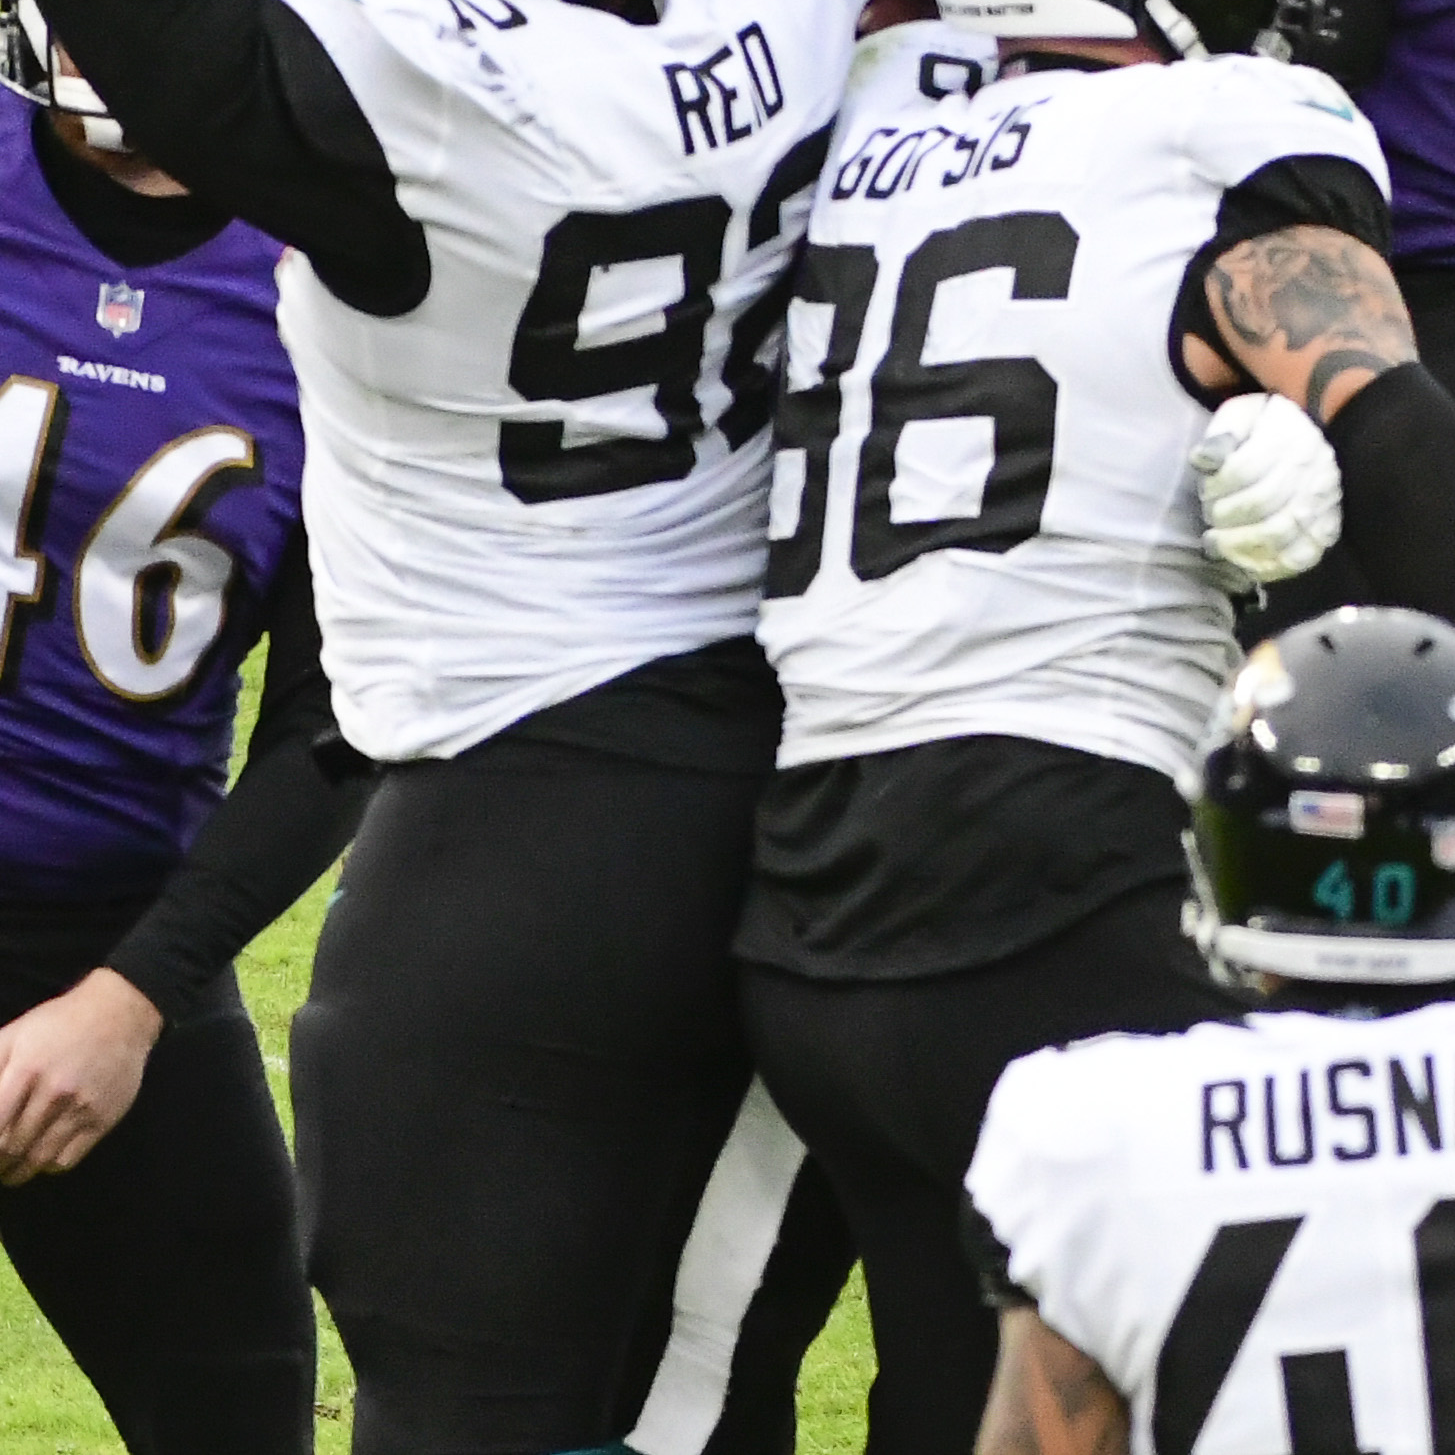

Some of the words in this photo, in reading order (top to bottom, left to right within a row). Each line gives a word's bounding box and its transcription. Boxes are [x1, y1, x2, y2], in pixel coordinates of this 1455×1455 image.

[57, 355, 166, 393] RAVENS
[0, 375, 254, 702] 46
[1314, 858, 1416, 928] 40
